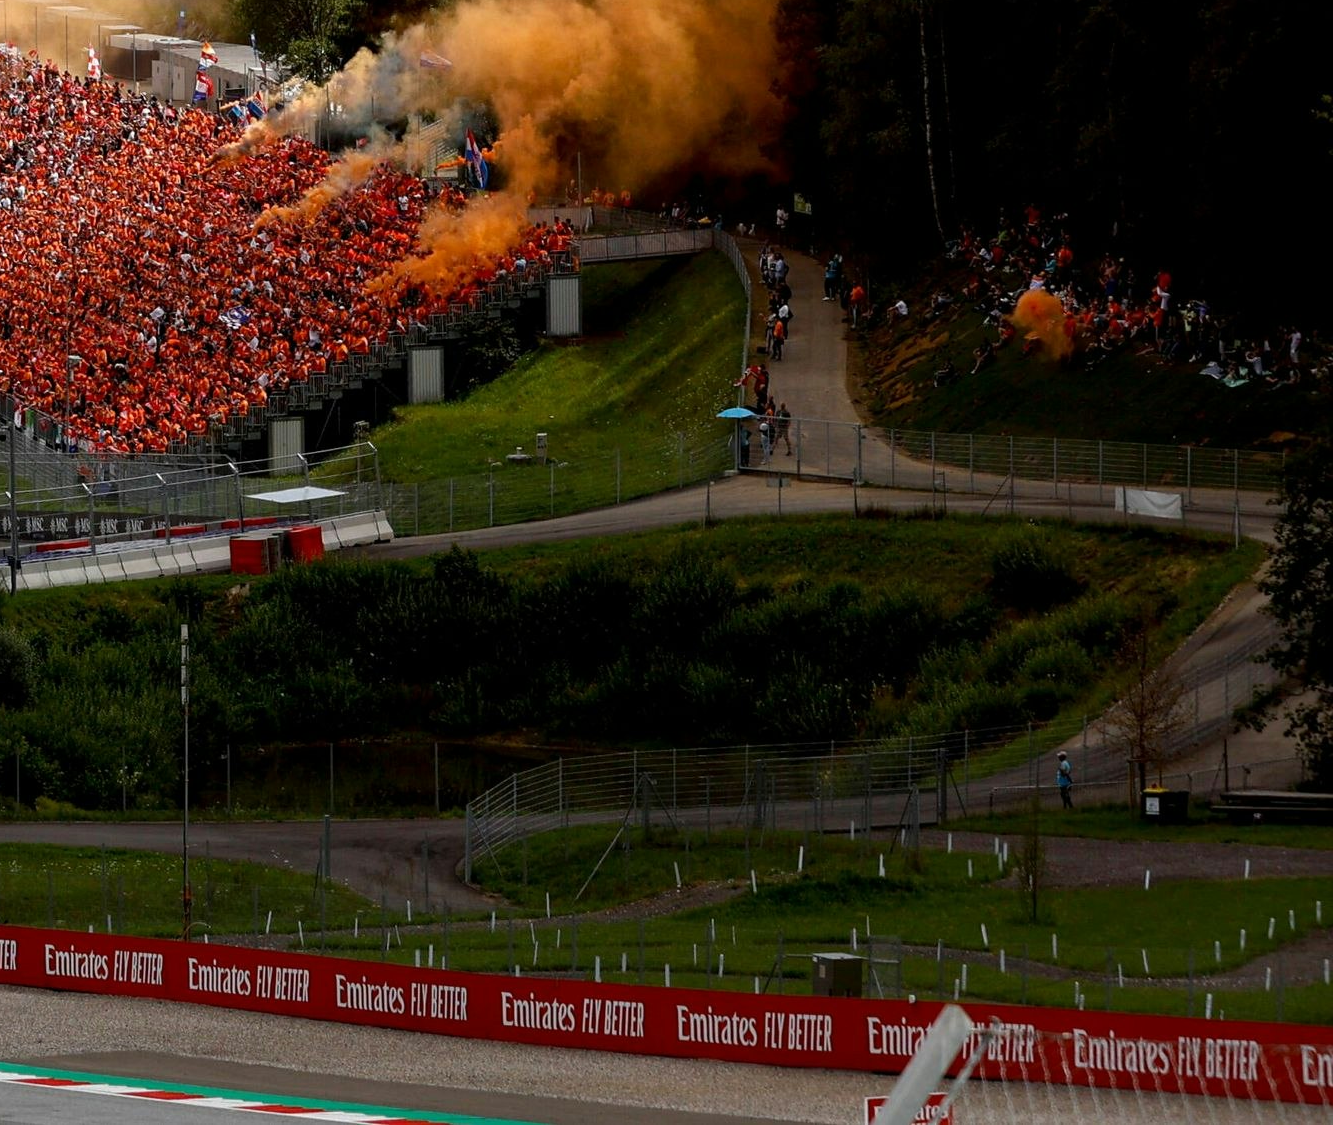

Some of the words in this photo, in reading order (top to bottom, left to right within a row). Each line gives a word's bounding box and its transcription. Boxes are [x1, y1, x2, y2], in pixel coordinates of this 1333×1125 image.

[45, 944, 109, 980] Emirates
[114, 950, 130, 982] FLY
[131, 952, 163, 986] BETTER
[188, 958, 251, 996] Emirates
[256, 965, 273, 999] FLY
[274, 967, 310, 1003] BETTER
[335, 974, 405, 1014] Emirates
[411, 982, 428, 1017] FLY
[431, 985, 467, 1021] BETTER
[501, 991, 575, 1032] Emirates
[582, 998, 602, 1034] FLY
[604, 1000, 645, 1038] BETTER
[676, 1005, 757, 1047] Emirates
[764, 1012, 785, 1049] FLY
[788, 1013, 832, 1052] BETTER
[867, 1016, 933, 1056] Emira
[1072, 1028, 1169, 1074] Emirates
[1177, 1036, 1201, 1076] FLY
[1206, 1038, 1258, 1081] BETTER
